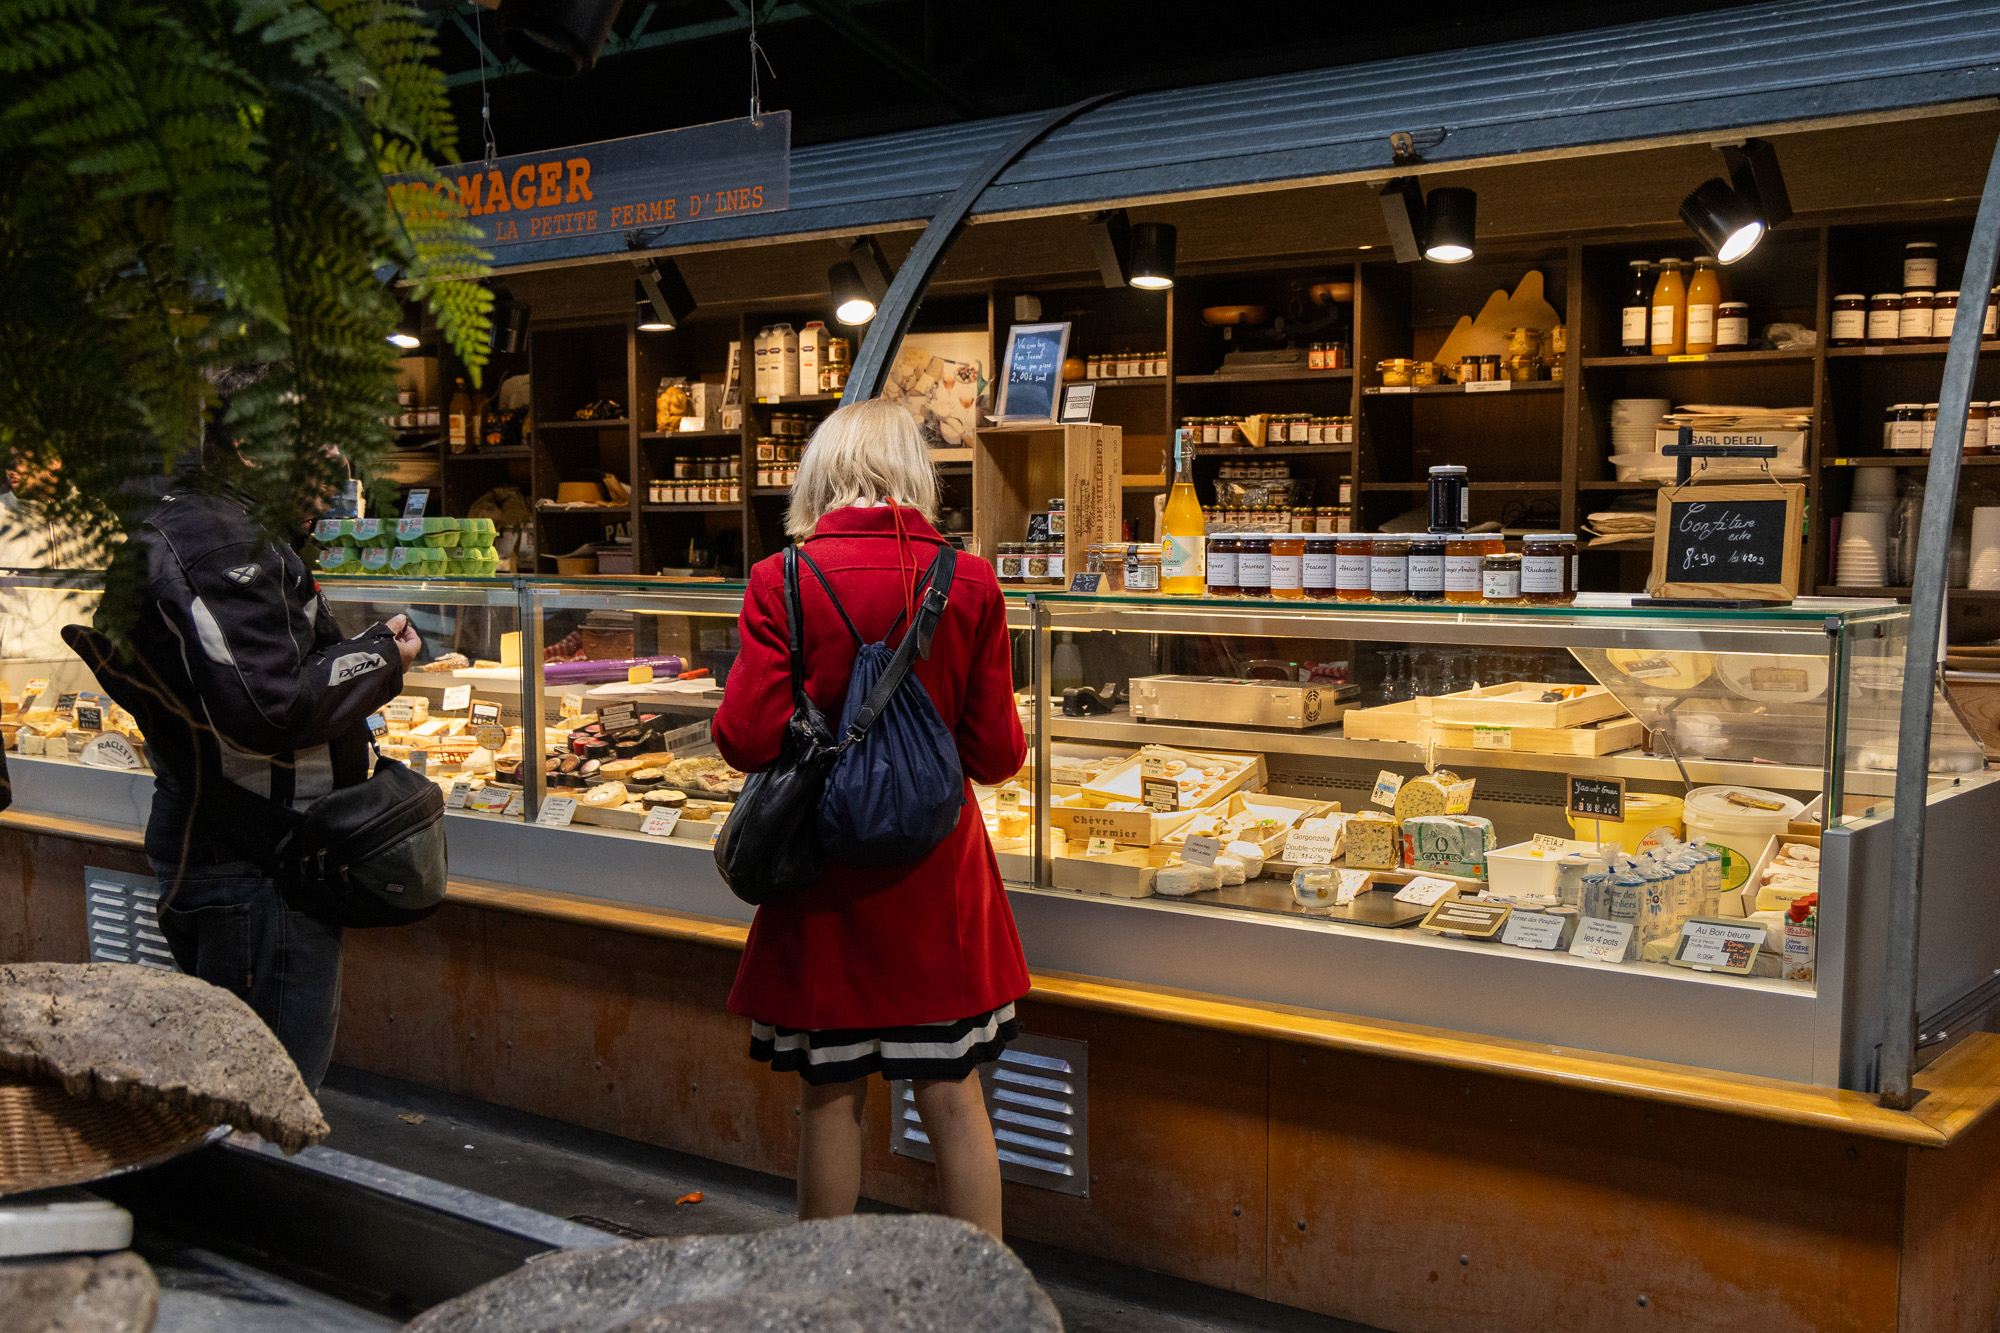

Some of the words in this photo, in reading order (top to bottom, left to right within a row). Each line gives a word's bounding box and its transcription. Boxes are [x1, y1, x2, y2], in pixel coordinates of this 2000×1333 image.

[496, 221, 519, 241] LA
[530, 210, 597, 237] PETITE
[610, 199, 677, 228] FERME
[690, 185, 763, 217] D'INES
[1069, 402, 1091, 410] EXPRESS
[1691, 435, 1721, 446] SARL
[1723, 435, 1763, 446] DELEU
[1096, 507, 1104, 522] DE
[1679, 502, 1756, 541] Confiture
[1305, 562, 1328, 571] Fraises
[1338, 564, 1364, 572] Abricots
[1410, 565, 1440, 574] Myrtilles
[1524, 565, 1557, 574] Rhubarbes
[97, 740, 135, 766] RACLETTE
[1073, 815, 1115, 826] Chèvre
[1088, 826, 1137, 838] Fermier
[1293, 832, 1330, 843] Gorgonzola
[1285, 843, 1333, 854] Double-crème
[1423, 852, 1461, 862] CARLES
[1510, 914, 1528, 922] Ferme
[1695, 926, 1707, 935] Au
[1709, 927, 1725, 937] Bon
[1727, 929, 1751, 940] beure
[1584, 933, 1595, 943] les
[1602, 937, 1619, 947] pots
[1785, 937, 1801, 945] Crème
[1588, 946, 1609, 957] 3.50€
[1785, 944, 1809, 952] ENTIÈRE
